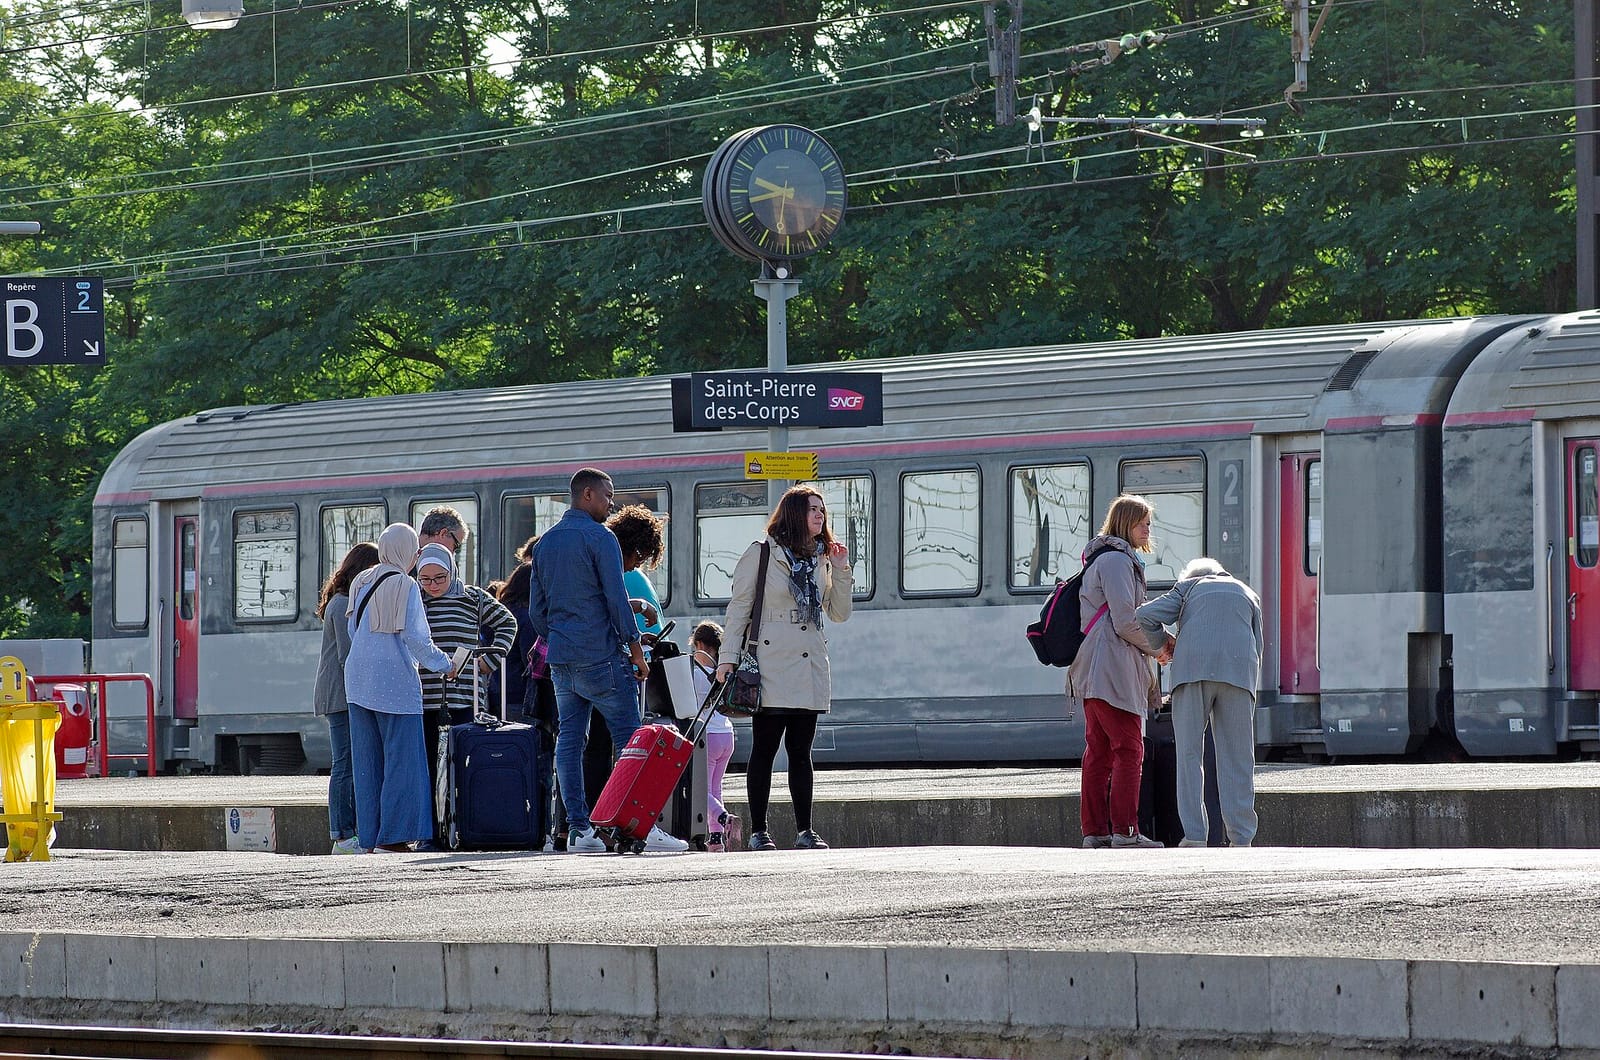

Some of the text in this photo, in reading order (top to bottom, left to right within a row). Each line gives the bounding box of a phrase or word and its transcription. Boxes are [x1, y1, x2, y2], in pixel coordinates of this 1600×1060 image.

[7, 282, 37, 293] Repère
[78, 290, 90, 310] 2
[6, 299, 44, 358] B
[704, 378, 817, 398] Saint-Pierre
[829, 395, 864, 408] SNCF
[704, 401, 800, 424] des-Corps
[1223, 463, 1239, 505] 2
[209, 519, 220, 555] 2
